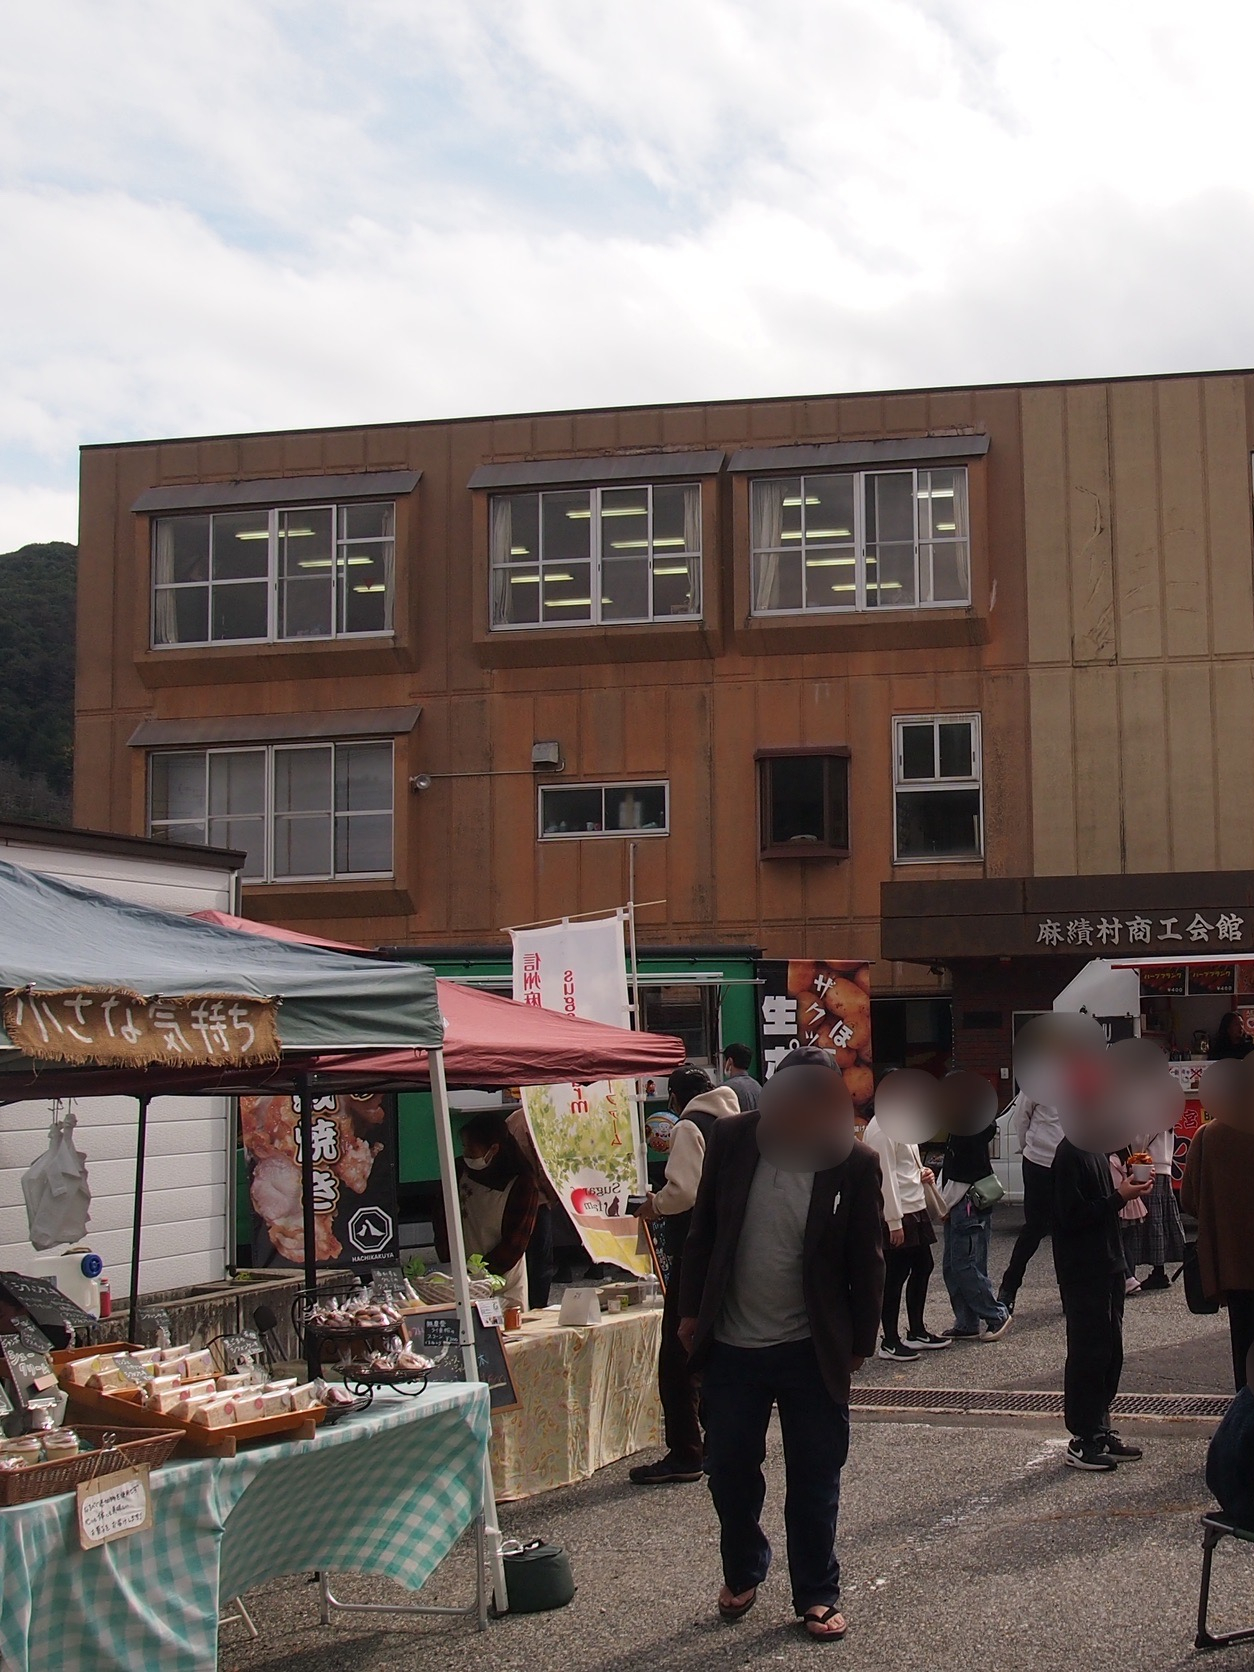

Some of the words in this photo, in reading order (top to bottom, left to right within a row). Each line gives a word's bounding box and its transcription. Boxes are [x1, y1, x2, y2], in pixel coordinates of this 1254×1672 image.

[1036, 913, 1245, 947] 麻績村商工会館
[16, 993, 255, 1054] 小さな気持ち
[351, 1252, 395, 1263] HACHIKAKUYA
